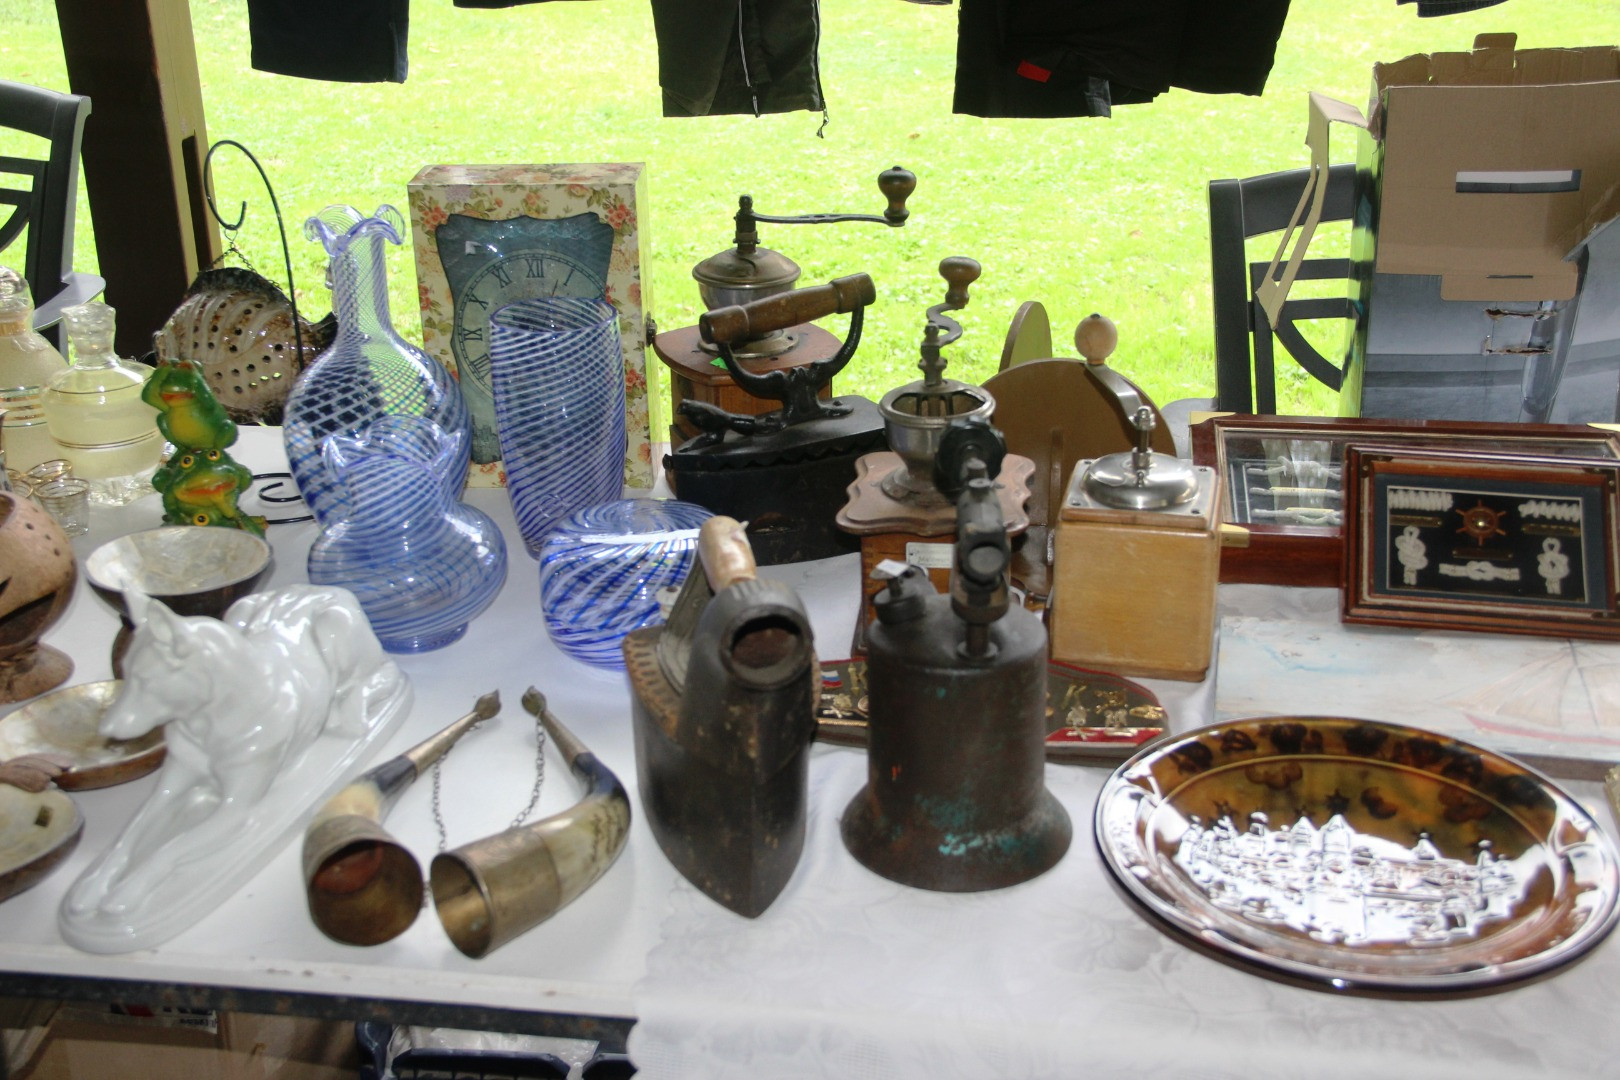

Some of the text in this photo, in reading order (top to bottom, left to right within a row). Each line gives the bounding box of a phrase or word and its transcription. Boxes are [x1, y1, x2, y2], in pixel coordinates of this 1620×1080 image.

[490, 264, 512, 288] XI
[525, 259, 545, 278] XII
[468, 294, 488, 311] X
[462, 327, 483, 341] IX
